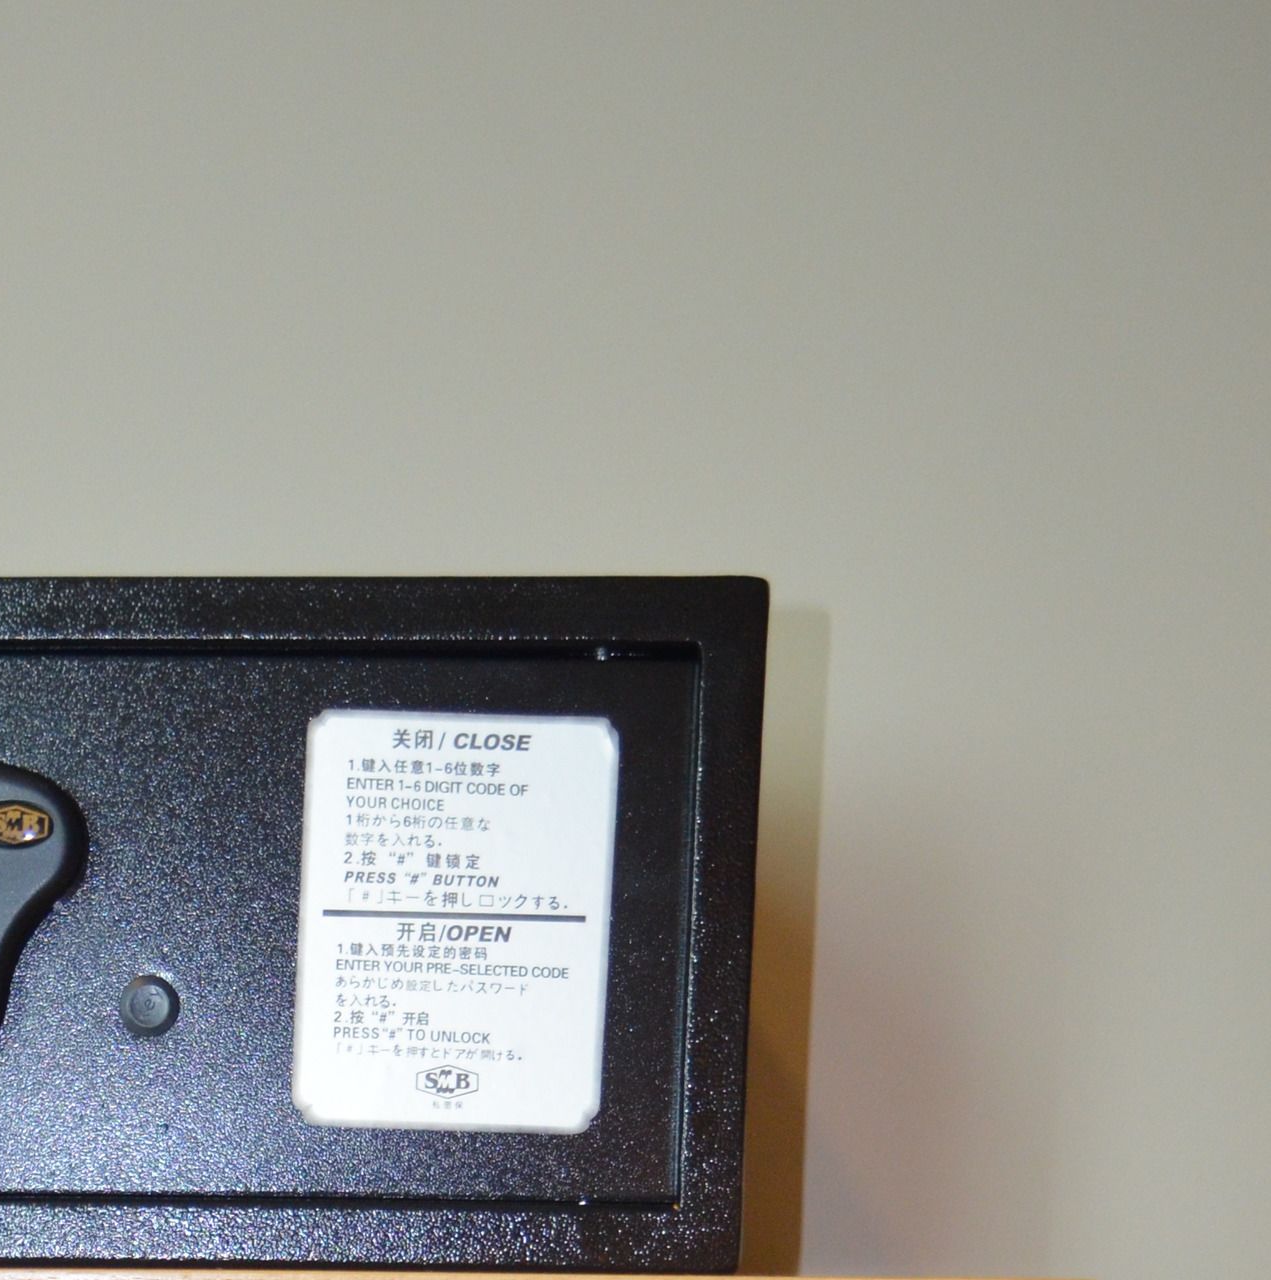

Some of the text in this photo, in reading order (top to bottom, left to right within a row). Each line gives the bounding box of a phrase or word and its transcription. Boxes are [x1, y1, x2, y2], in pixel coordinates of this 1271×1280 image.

[453, 732, 532, 752] CLOSE
[346, 777, 529, 797] ENTER 1-6 DIGIT CODE OF
[346, 796, 445, 812] YOUR CHOICE
[343, 870, 397, 885] PRESS
[432, 873, 500, 888] BUTTON
[335, 959, 569, 980] ENTER YOUR PRE-SELECTED CODE
[402, 1011, 430, 1026] 开启
[333, 1026, 380, 1039] PRESS
[407, 1028, 426, 1041] TO
[430, 1030, 491, 1044] UNLOCK
